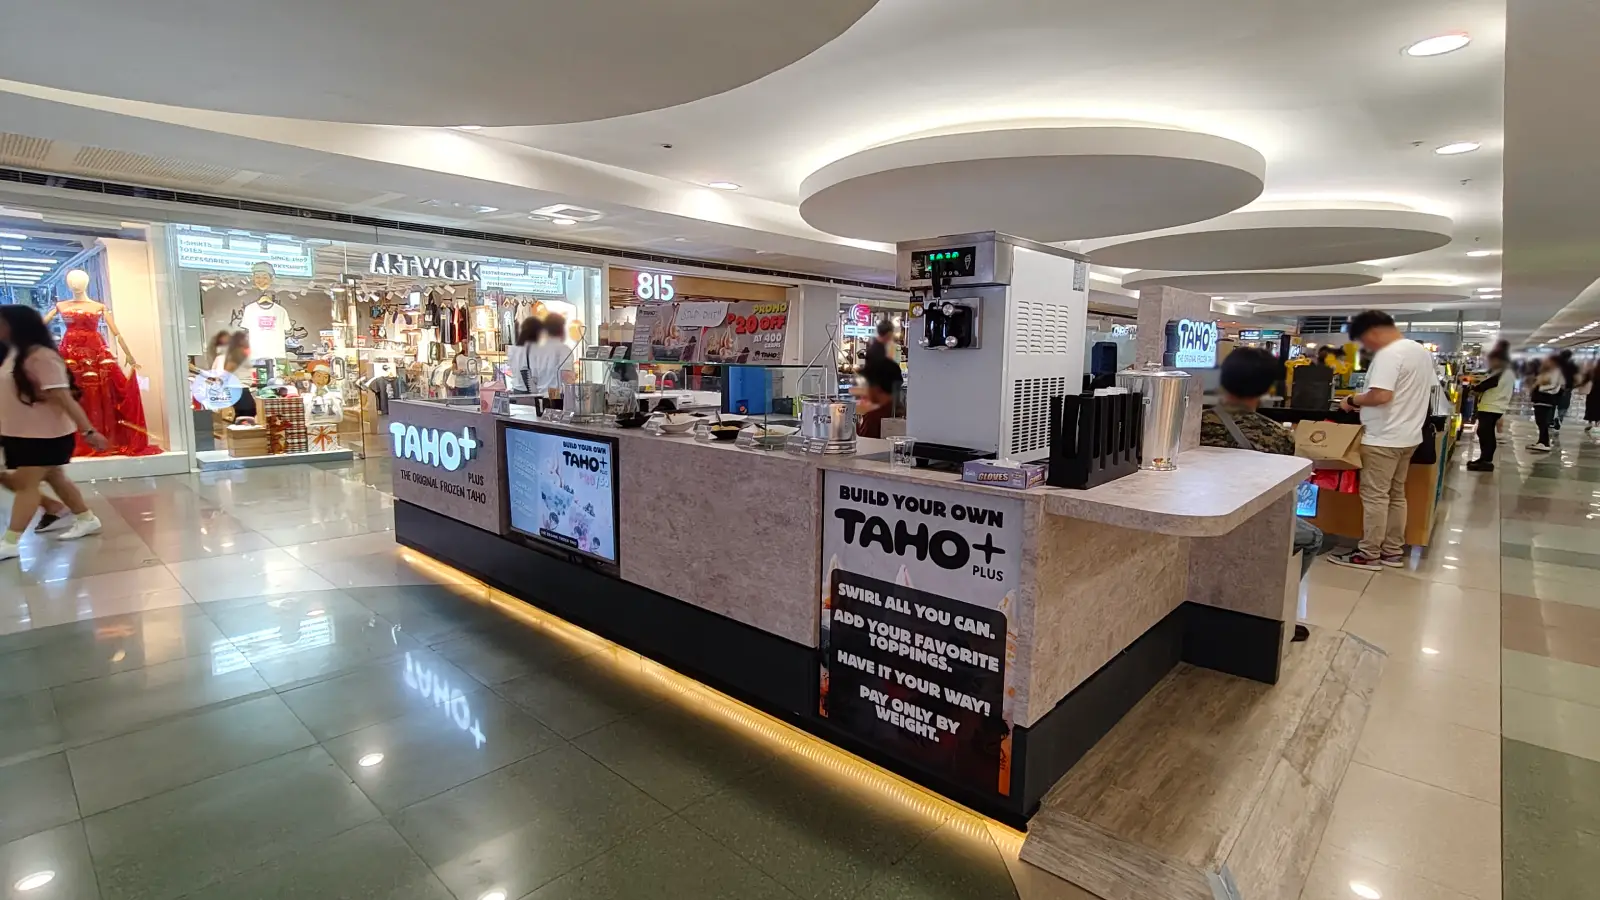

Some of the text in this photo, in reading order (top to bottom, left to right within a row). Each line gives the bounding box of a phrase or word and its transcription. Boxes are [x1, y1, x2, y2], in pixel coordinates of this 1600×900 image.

[370, 252, 481, 282] ARTWORK
[637, 272, 675, 300] 815
[752, 303, 787, 314] PROMO
[760, 314, 786, 330] OFF
[764, 332, 782, 344] 400
[390, 422, 477, 472] TAHO+
[562, 450, 608, 472] TAHO+
[563, 441, 577, 449] BUILD
[578, 444, 592, 452] YOUR
[400, 470, 486, 504] THE ORIGINAL FROZEN TAHO
[468, 472, 484, 486] PLUS
[978, 472, 1008, 481] GLOVES
[839, 485, 1004, 528] BUILD YOUR OWN
[834, 508, 1006, 570] TAHO+
[972, 565, 1004, 582] PLUS
[838, 582, 996, 640] SWIRL ALL YOU CAN.
[834, 609, 1000, 673] ADD YOUR FAVORITE
[869, 633, 953, 673] TOPPINGS.
[837, 650, 991, 717] HAVE IT YOUR WAY!
[860, 685, 960, 735] PAY ONLY BY
[875, 705, 940, 743] WEIGHT.
